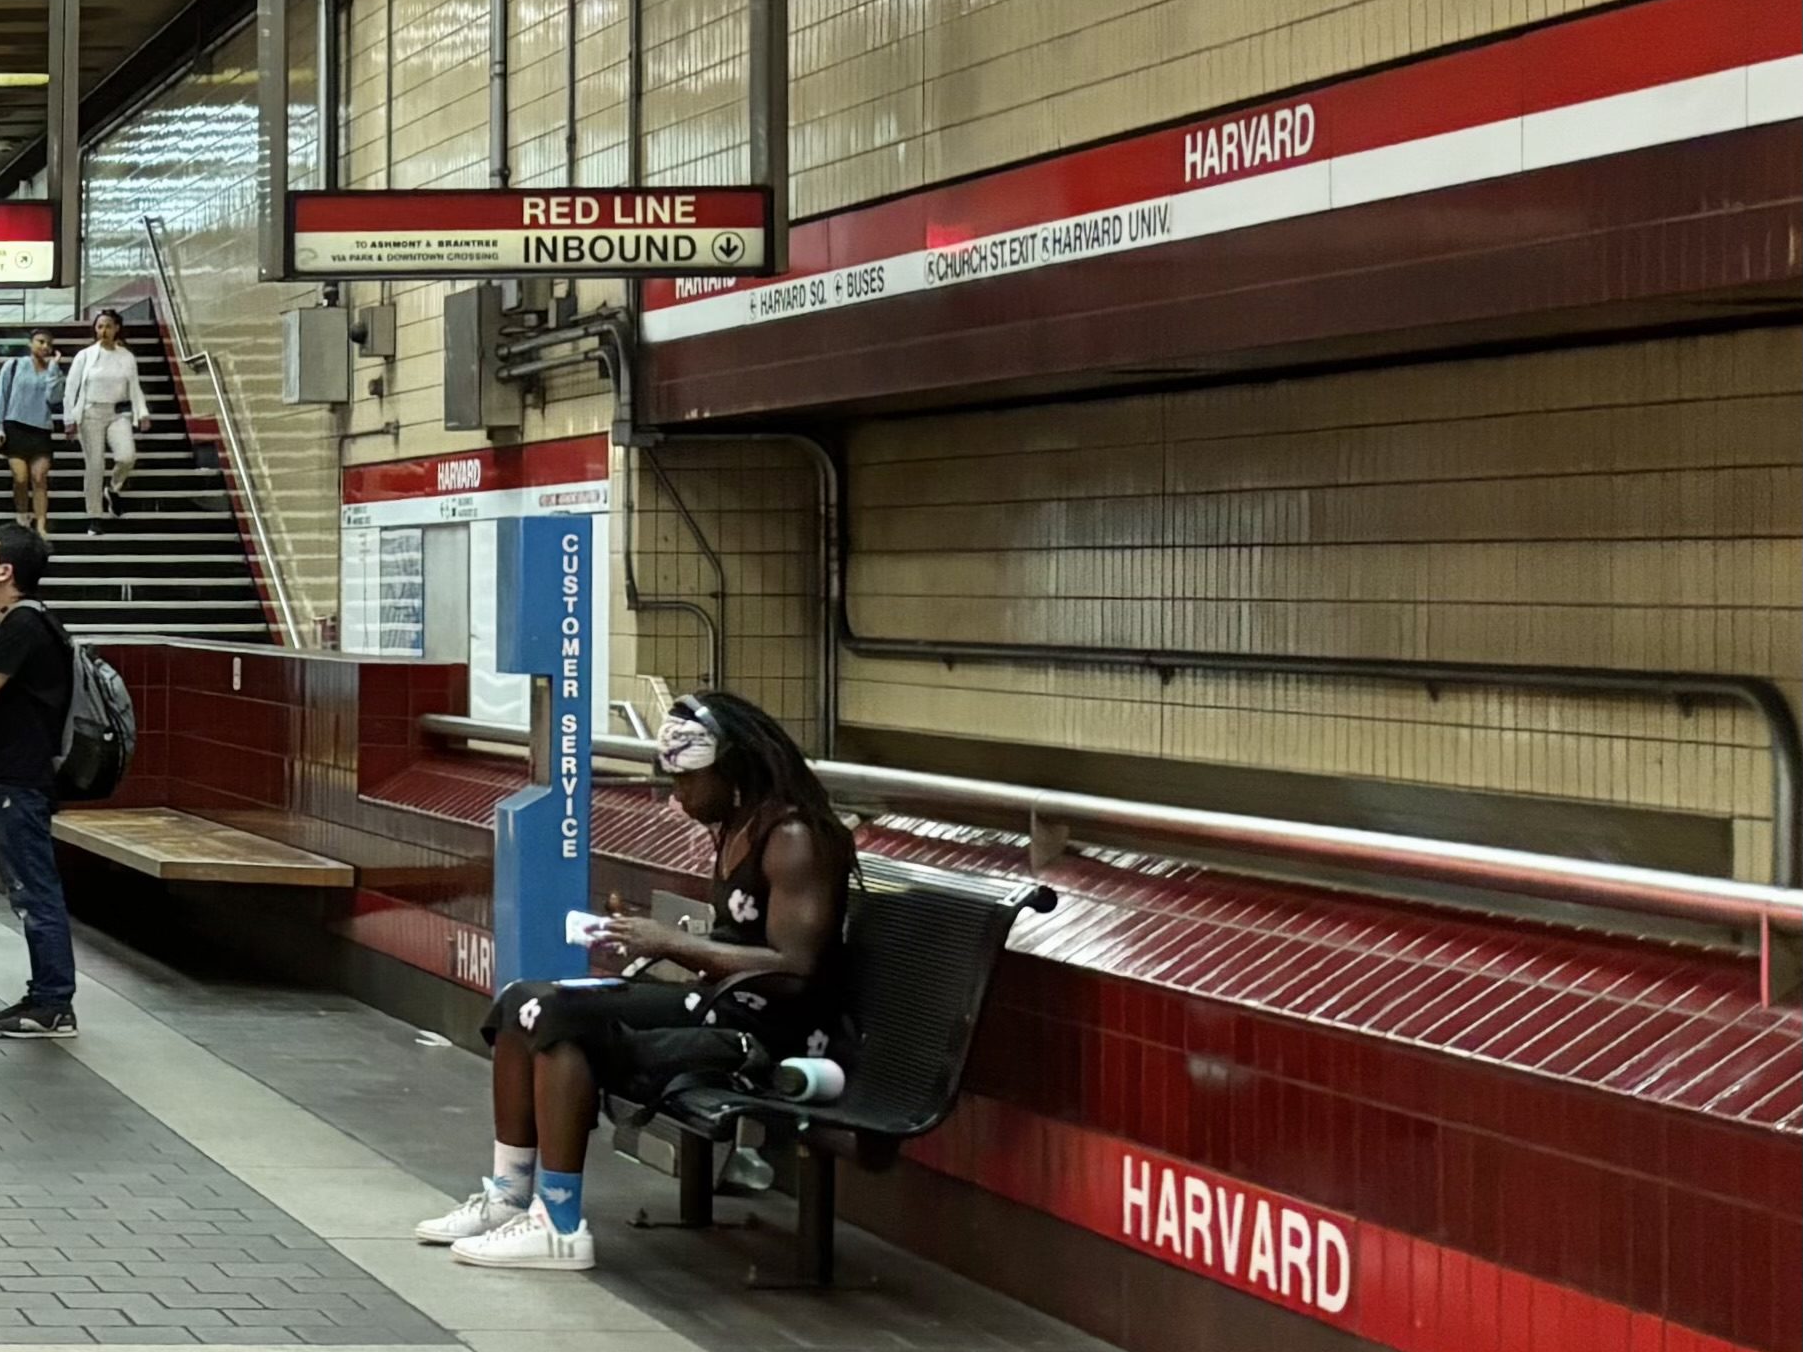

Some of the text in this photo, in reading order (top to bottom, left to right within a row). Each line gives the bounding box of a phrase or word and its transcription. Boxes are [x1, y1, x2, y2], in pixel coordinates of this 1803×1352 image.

[1185, 103, 1316, 183] HARVARD
[522, 195, 697, 225] RED LINE
[331, 254, 347, 262] VIA
[349, 253, 373, 262] PARK
[387, 253, 444, 261] DOWNTOWN
[447, 252, 499, 261] CROSSING
[355, 240, 369, 249] TO
[370, 240, 422, 249] ASHMONT
[438, 239, 499, 248] BRAINTREE
[523, 234, 697, 264] INBOUND
[936, 248, 988, 282] CHURCH
[1009, 233, 1038, 268] EXIT
[1052, 214, 1123, 256] HARVARD
[1128, 202, 1171, 241] UNIV.
[760, 283, 806, 316] HARVARD
[847, 266, 885, 298] BUSES
[437, 458, 481, 490] HARVARD
[561, 534, 580, 698] CUSTOMER
[561, 714, 579, 858] SERVICE
[457, 929, 495, 990] HAR
[1123, 1155, 1350, 1314] HARVARD
